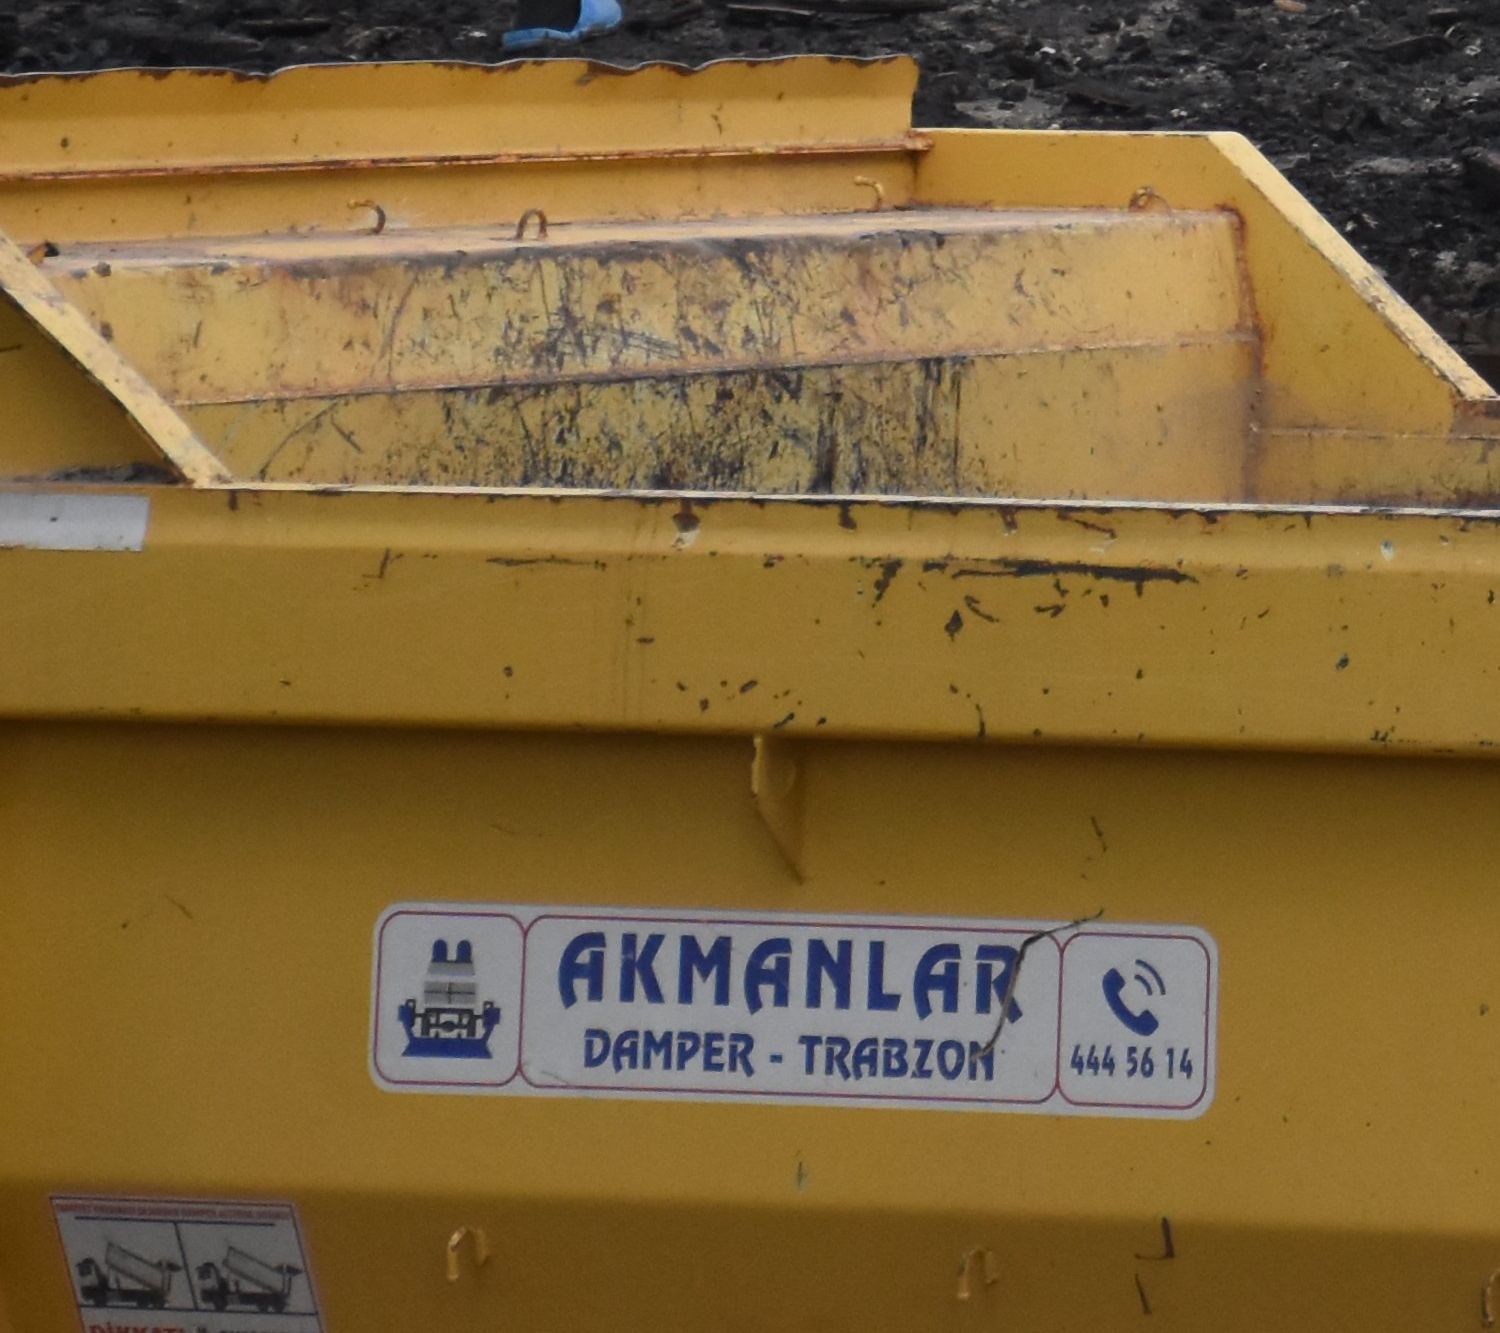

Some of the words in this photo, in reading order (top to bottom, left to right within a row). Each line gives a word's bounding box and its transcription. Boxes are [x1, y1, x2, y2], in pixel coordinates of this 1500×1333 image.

[558, 931, 1024, 1024] AKMANLAR
[583, 1029, 755, 1079] DAMPER
[798, 1035, 995, 1082] TRABZON
[1071, 1044, 1116, 1077] 444
[1127, 1046, 1154, 1078] 56
[1167, 1047, 1195, 1080] 14
